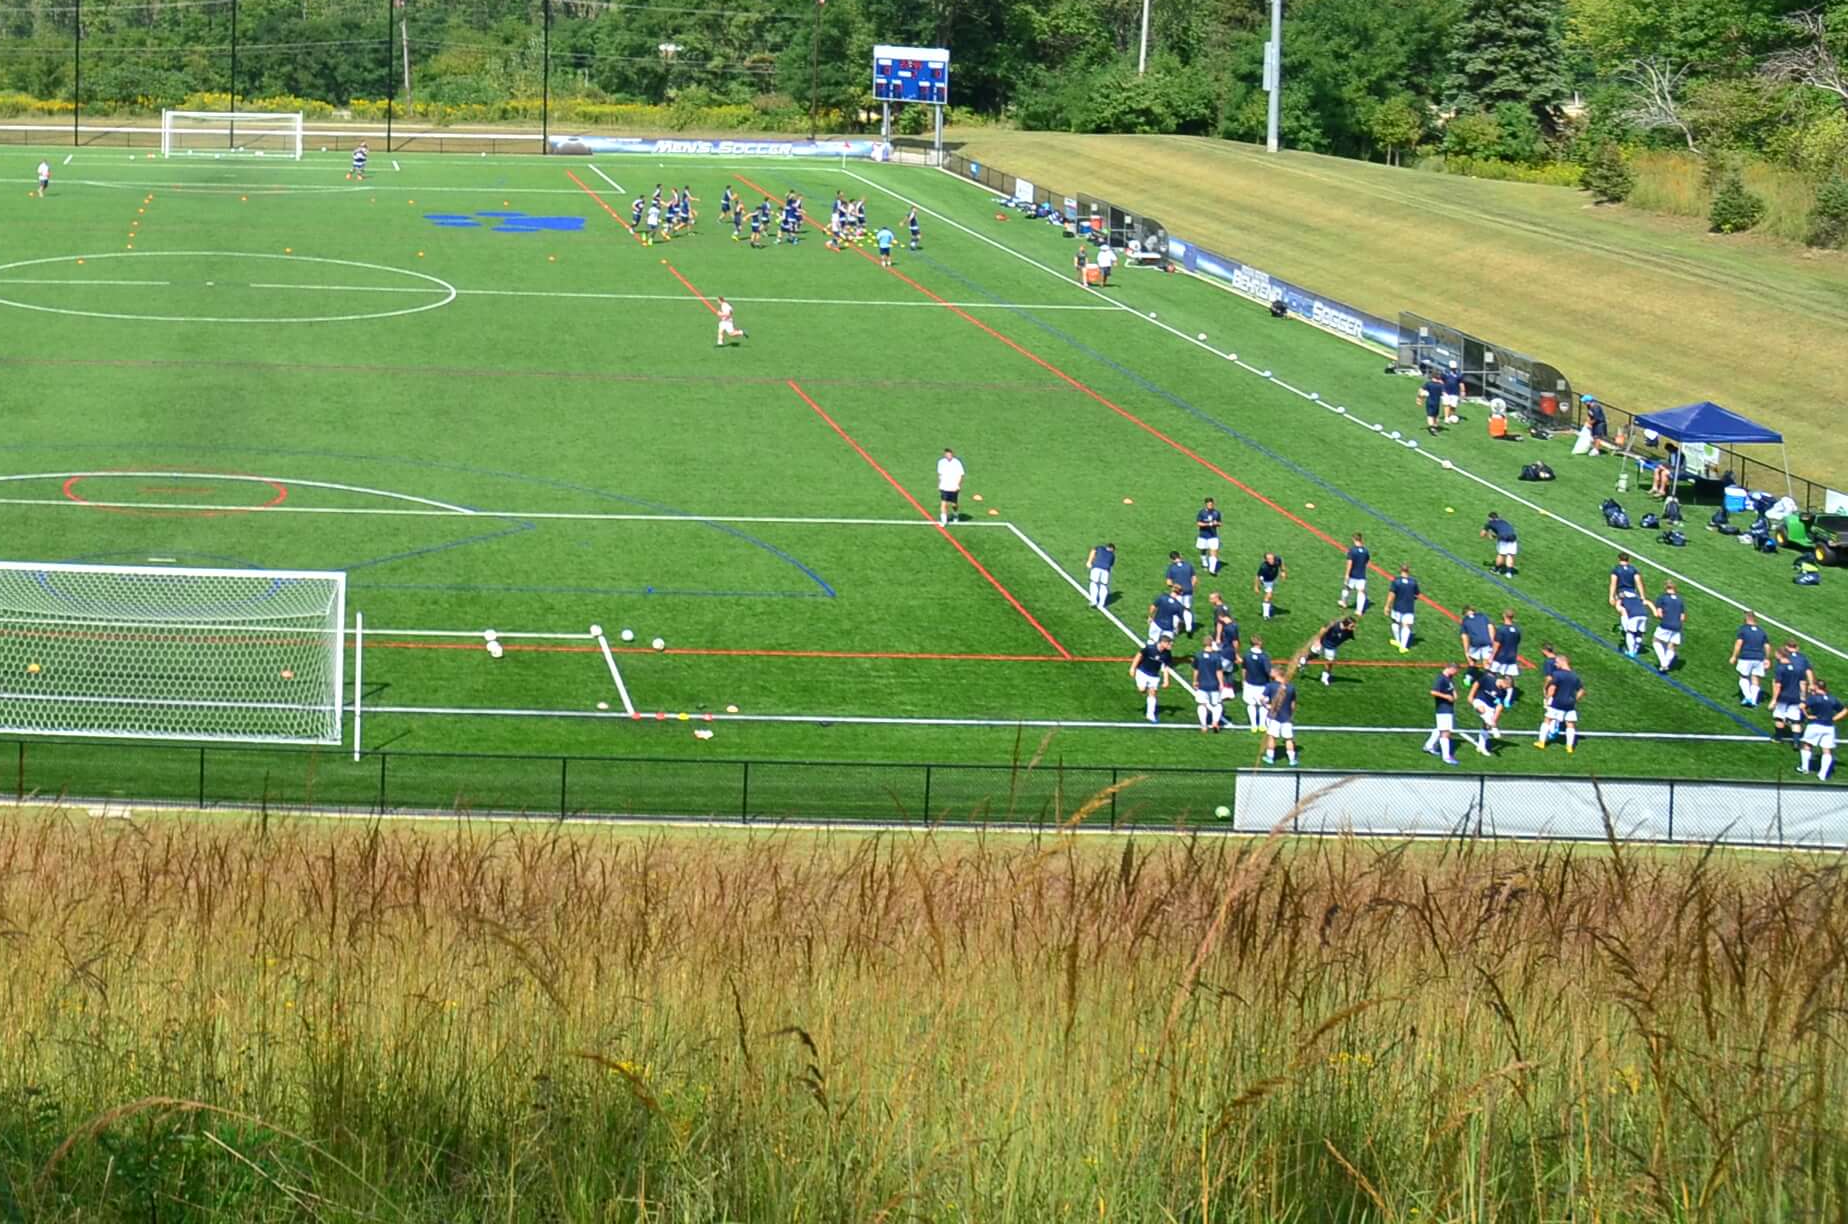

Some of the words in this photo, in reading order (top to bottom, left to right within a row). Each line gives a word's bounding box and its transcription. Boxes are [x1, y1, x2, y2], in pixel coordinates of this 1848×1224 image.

[718, 141, 793, 156] SOCCER
[1232, 268, 1282, 301] BEHREND
[1312, 300, 1363, 338] SOCCER
